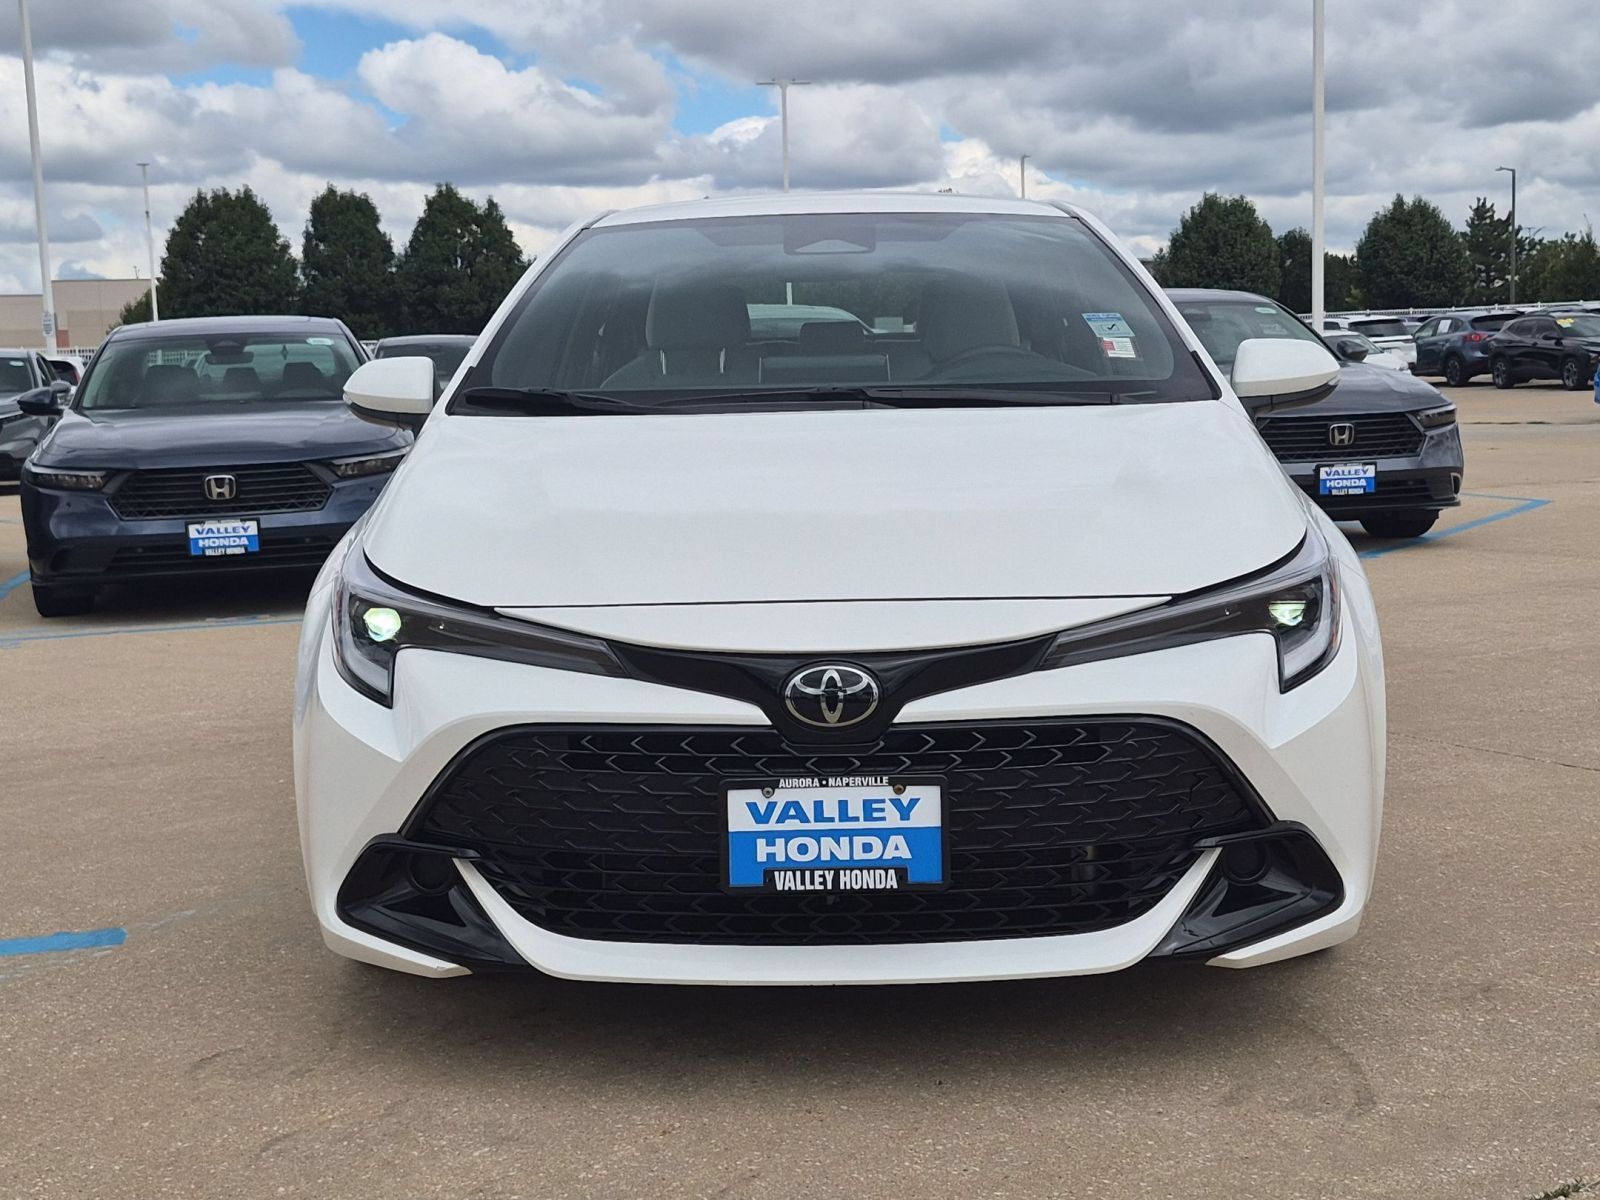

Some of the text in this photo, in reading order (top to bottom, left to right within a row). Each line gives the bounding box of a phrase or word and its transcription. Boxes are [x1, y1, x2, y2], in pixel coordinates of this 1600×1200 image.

[1324, 468, 1369, 477] VALLEY
[1326, 478, 1367, 488] HONDA
[194, 525, 250, 536] VALLEY
[198, 536, 249, 548] HONDA
[778, 776, 889, 788] AURORA NAPERVILLE
[745, 797, 921, 825] VALLEY
[756, 835, 912, 862] HONDA
[774, 869, 898, 891] VALLEY HONDA
